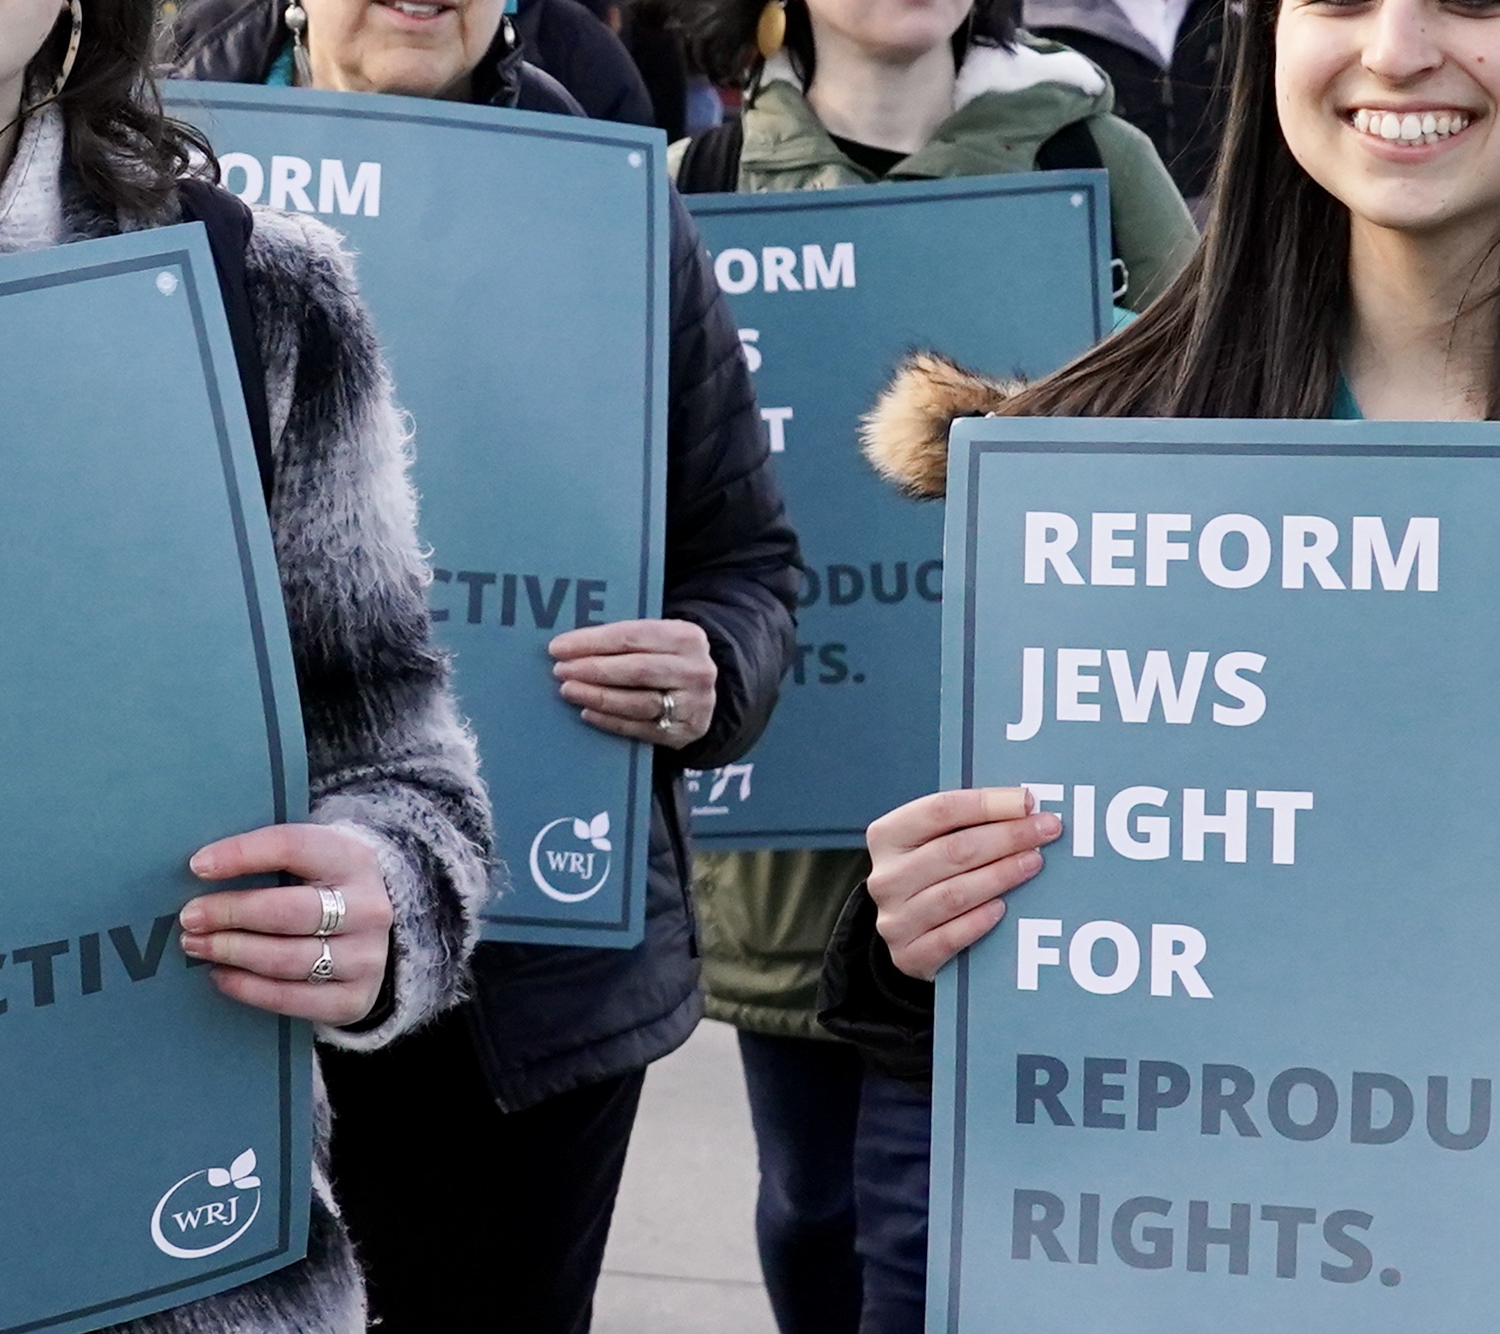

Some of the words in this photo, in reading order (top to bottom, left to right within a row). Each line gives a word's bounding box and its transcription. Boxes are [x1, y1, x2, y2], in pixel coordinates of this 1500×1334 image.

[217, 152, 381, 217] ORM
[706, 242, 856, 295] ORM
[1024, 511, 1440, 592] REFORM
[1006, 647, 1267, 741] JEWS
[546, 851, 596, 880] WRJ
[1017, 918, 1214, 999] FOR
[172, 1196, 239, 1232] WRJ
[1010, 1189, 1403, 1288] RIGHTS.
